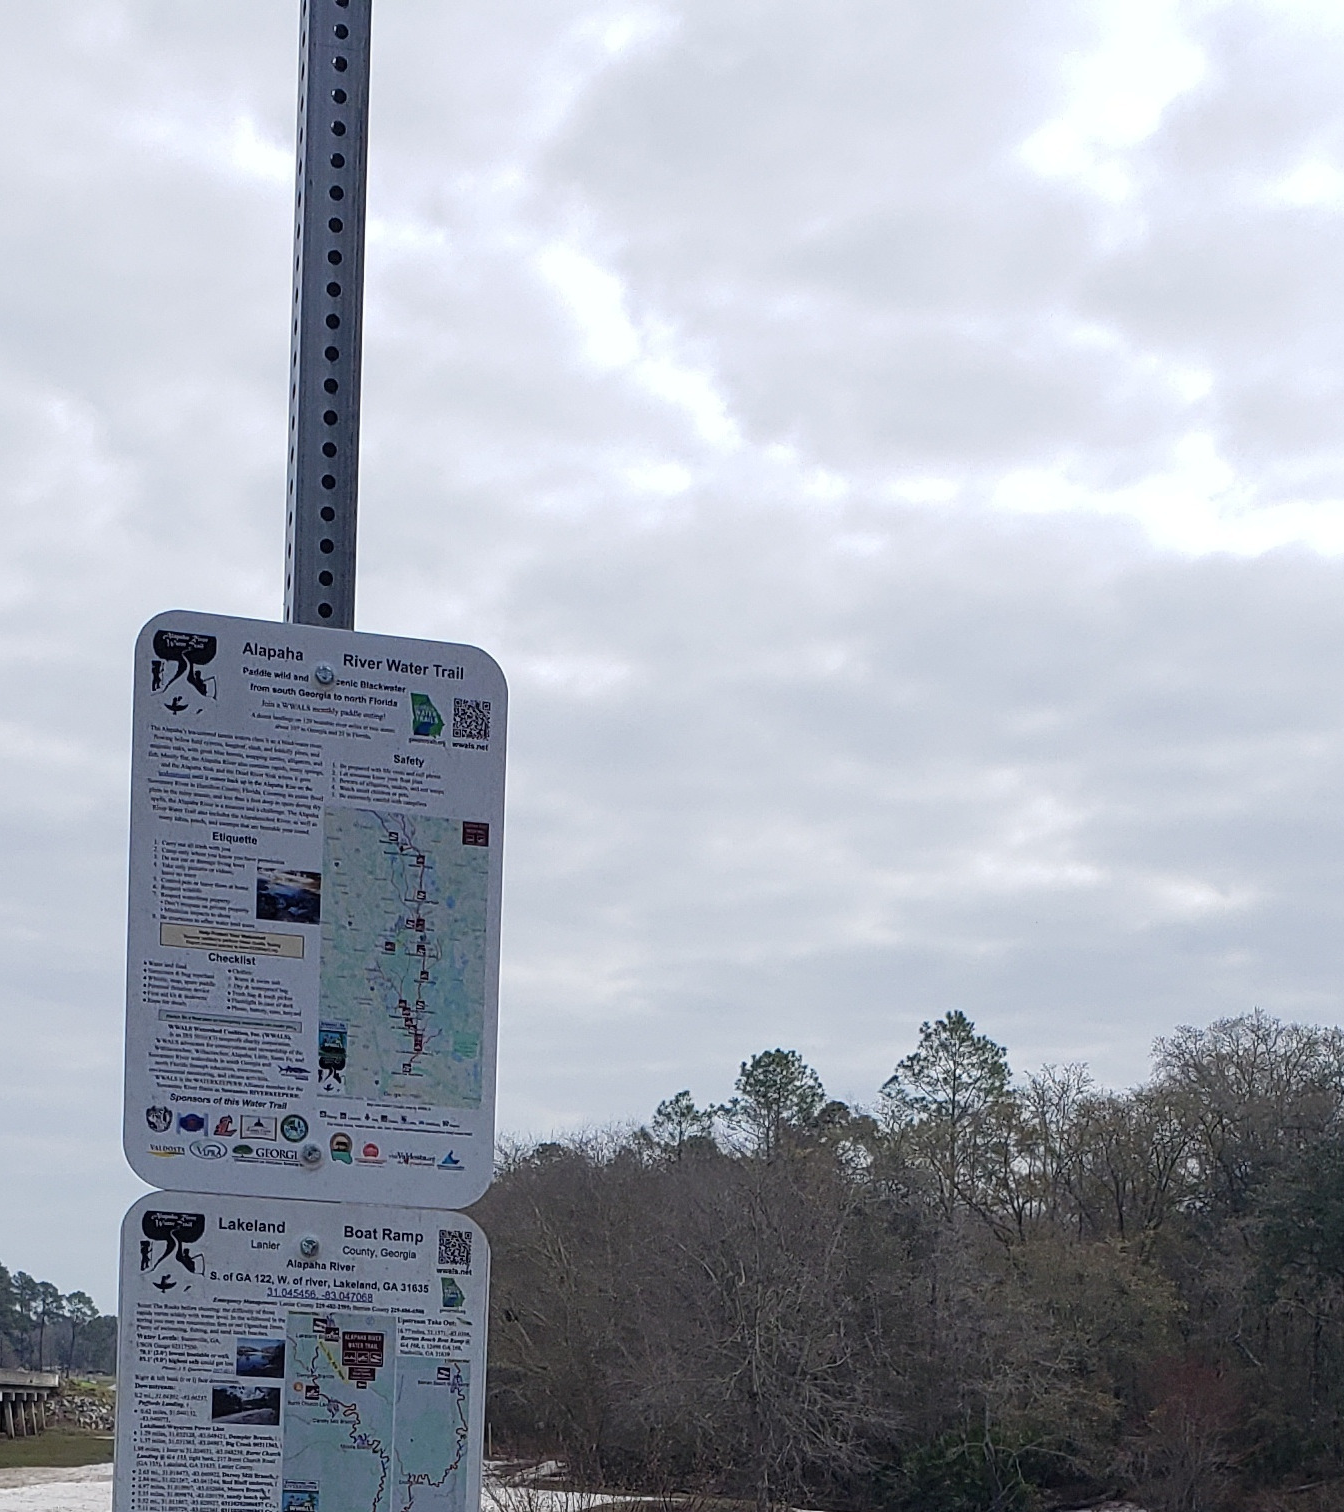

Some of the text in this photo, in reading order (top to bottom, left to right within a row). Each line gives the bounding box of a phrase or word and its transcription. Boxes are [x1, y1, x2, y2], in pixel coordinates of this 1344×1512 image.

[243, 642, 464, 680] Alapaha River Water Trail
[243, 667, 271, 678] Paddle
[274, 670, 291, 681] wild
[294, 673, 309, 682] and
[360, 681, 406, 694] Blackwater
[250, 683, 398, 708] from south Georgia to north Florida
[393, 754, 424, 768] Safety
[213, 832, 257, 845] Etiquette
[208, 952, 257, 966] Checklist
[170, 1094, 287, 1110] Sponsors of this Water Trail
[256, 1148, 298, 1160] GEORGI
[219, 1217, 424, 1246] Lakeland Boat Ramp
[251, 1240, 417, 1260] Lanier County, Georgia
[287, 1259, 356, 1272] Alapaha River
[209, 1271, 429, 1294] S. of GA 122, W. of river, Lakeland, GA 31635
